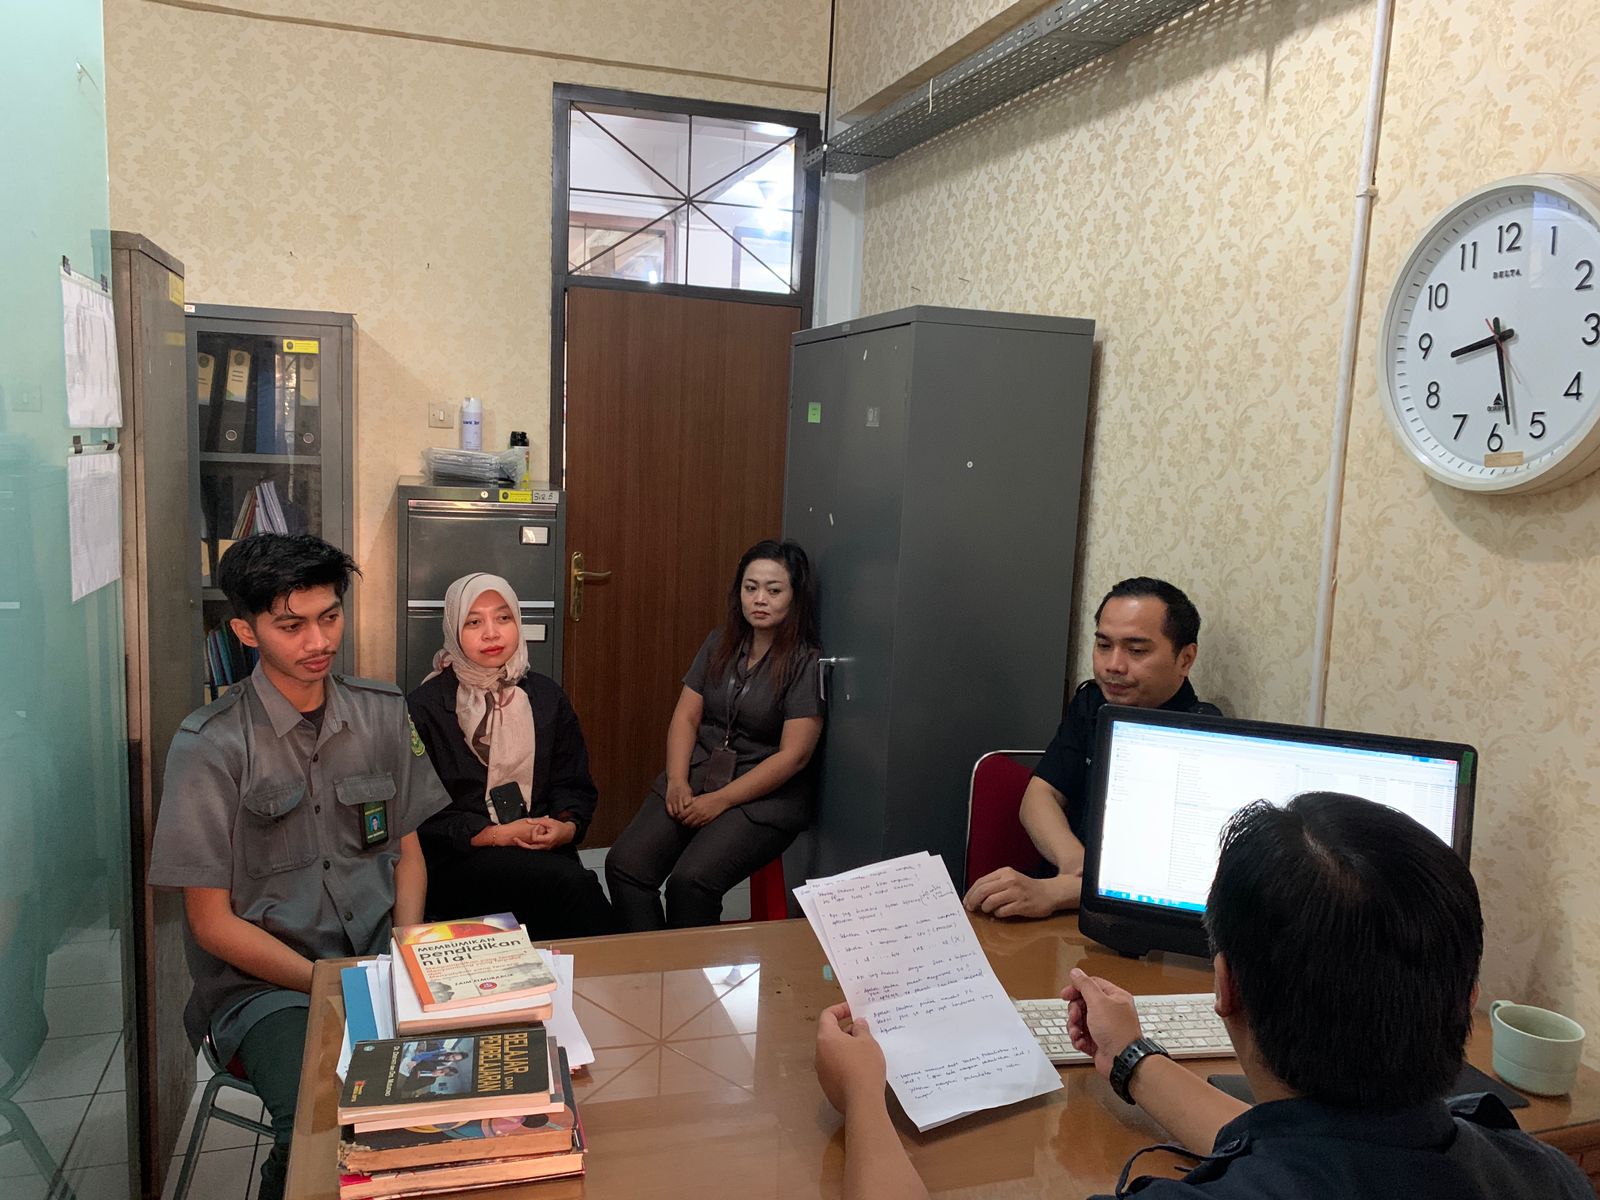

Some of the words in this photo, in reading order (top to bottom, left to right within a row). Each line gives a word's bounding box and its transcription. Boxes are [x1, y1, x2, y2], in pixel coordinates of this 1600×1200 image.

[1497, 222, 1521, 253] 12
[1550, 226, 1557, 255] 1
[1460, 241, 1478, 271] 11
[1493, 269, 1522, 279] DELTA
[1575, 260, 1593, 291] 2
[1427, 283, 1449, 311] 10
[1582, 313, 1600, 346] 3
[1418, 333, 1433, 360] 9
[1426, 381, 1440, 409] 8
[1563, 371, 1583, 401] 4
[1452, 413, 1469, 440] 7
[1487, 423, 1503, 452] 6
[1529, 411, 1546, 439] 5
[417, 937, 496, 952] MEMBUMIKAN
[419, 940, 521, 960] pendidikan
[422, 954, 473, 967] nilai
[477, 1034, 502, 1092] PEMBELAJARAN
[503, 1032, 529, 1075] BELAJAR
[504, 1076, 514, 1090] DAN
